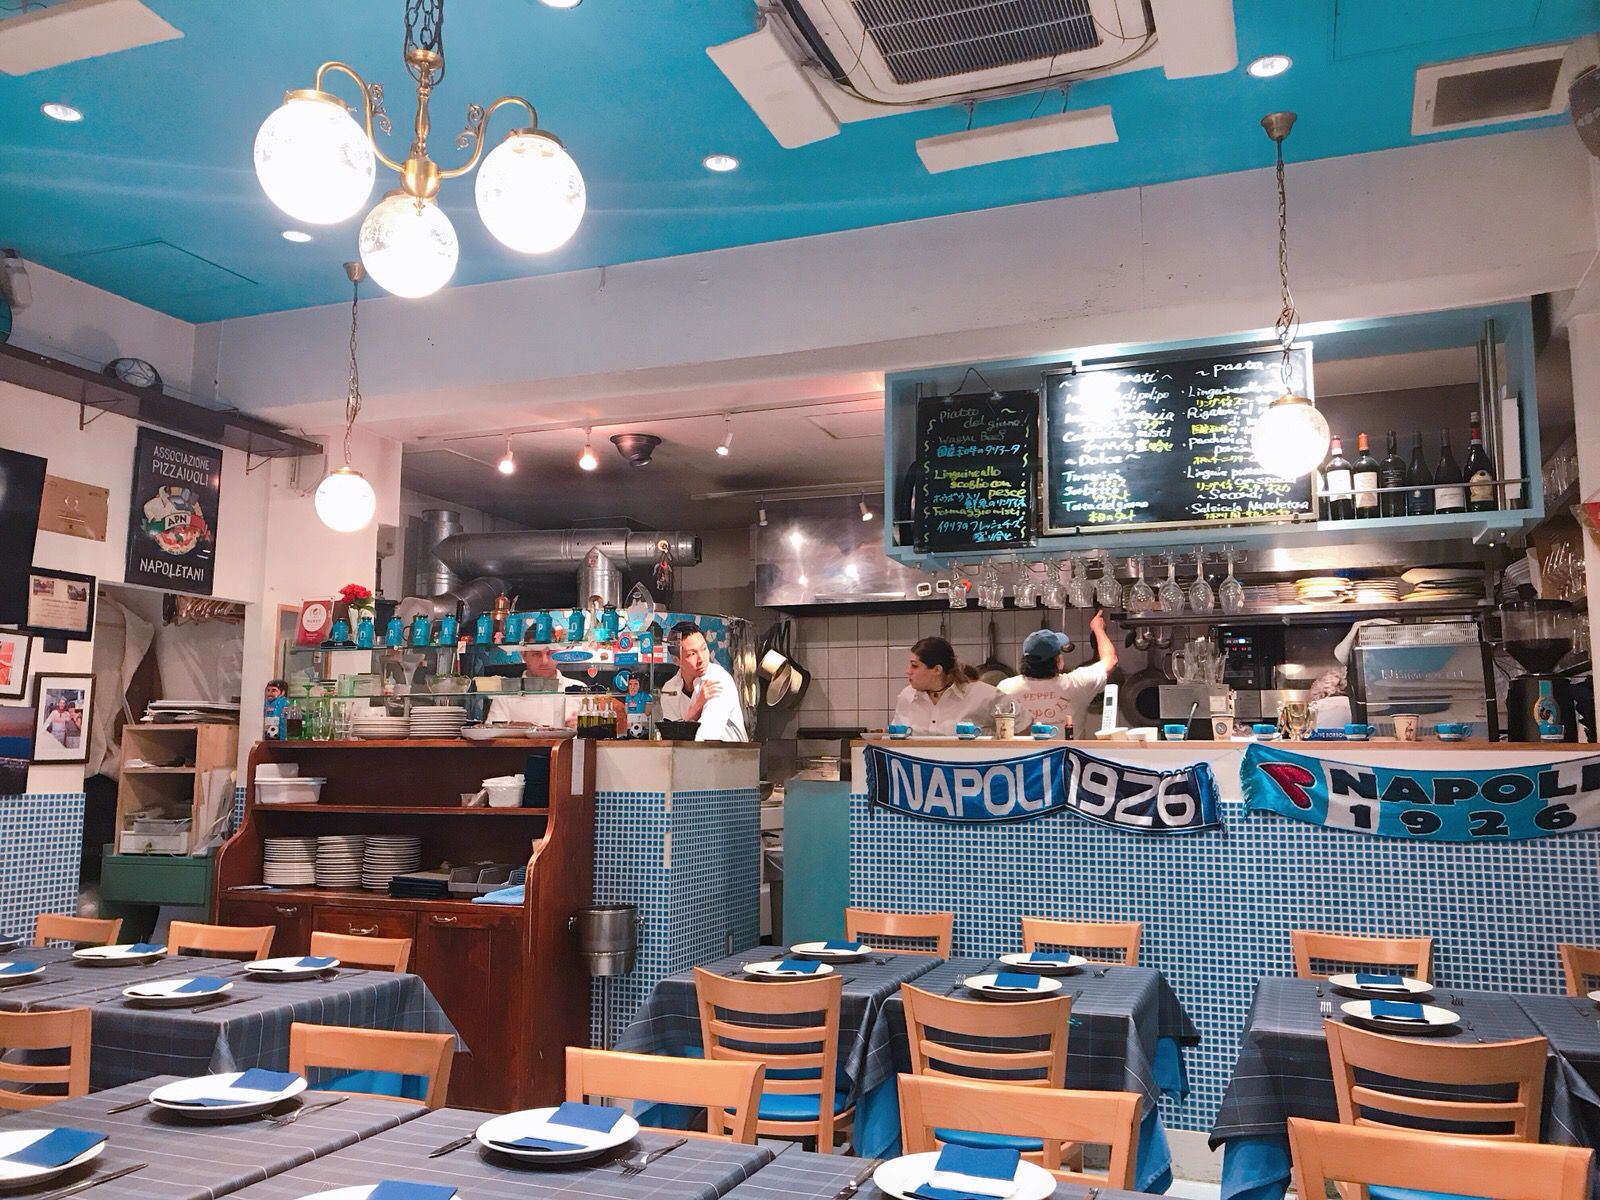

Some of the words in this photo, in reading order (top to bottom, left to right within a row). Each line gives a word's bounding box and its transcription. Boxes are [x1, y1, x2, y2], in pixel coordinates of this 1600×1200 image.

[153, 445, 210, 471] ASSOCIAZIONE
[152, 459, 209, 487] PIZZAIUOLI
[167, 514, 188, 528] APN
[139, 557, 204, 582] NAPOLETANI
[890, 756, 1051, 817] NAPOLI
[1066, 750, 1195, 827] 1926
[1349, 802, 1578, 837] 1926
